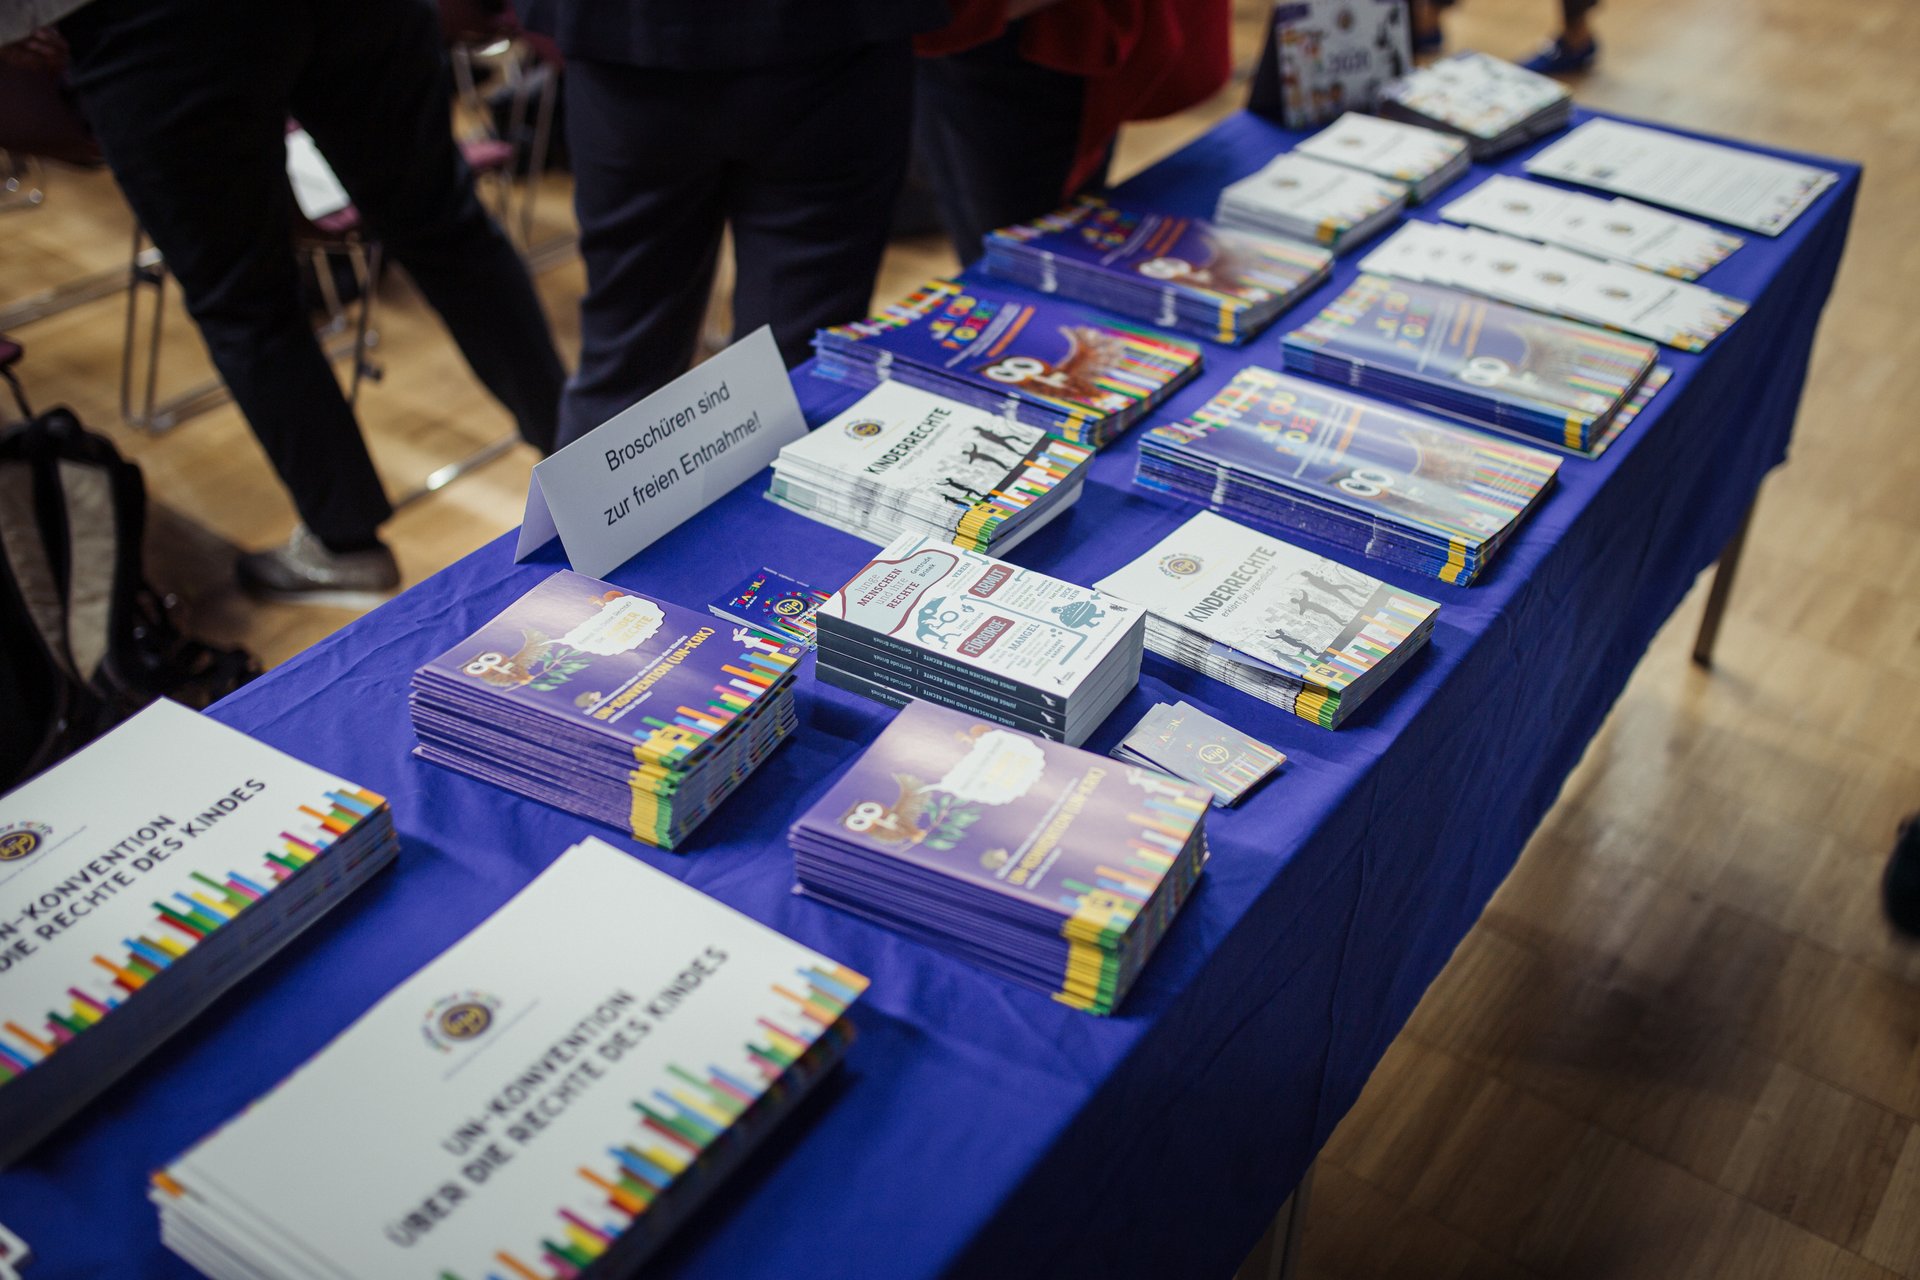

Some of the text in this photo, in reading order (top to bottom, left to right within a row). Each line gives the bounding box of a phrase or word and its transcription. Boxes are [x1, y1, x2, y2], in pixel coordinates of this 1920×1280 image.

[605, 381, 730, 471] Broschüren sind
[864, 407, 951, 475] KINDERRECHTE
[604, 411, 762, 526] zur freien Entnahme!
[911, 556, 932, 574] Gertrude
[857, 568, 902, 606] MENSCHEN
[887, 581, 920, 608] RECHTE
[975, 569, 1007, 594] ARMUT
[1184, 546, 1276, 622] KINDERRECHTE
[778, 600, 801, 614] kija
[666, 627, 715, 664] (UN-KRK)
[963, 619, 1007, 654] FÜRSORGE
[1008, 623, 1040, 651] MANGEL
[923, 654, 943, 665] RECHTE
[956, 666, 968, 675] UND
[923, 672, 943, 683] RECHTE
[956, 684, 969, 693] UND
[969, 670, 998, 685] MENSCHEN
[887, 694, 908, 705] ertrude
[923, 689, 943, 700] RECHTE
[956, 701, 968, 710] UND
[969, 688, 999, 704] MENSCHEN
[968, 706, 998, 720] MENSCHEN
[35, 871, 136, 941] RECHTE
[131, 836, 184, 873] DES
[179, 778, 266, 838] KINDES
[0, 815, 176, 942] N-KONVENTION
[441, 990, 636, 1156] UN-KONVENTION
[461, 1143, 513, 1184] DIE
[505, 1060, 605, 1145] RECHTE
[598, 1018, 652, 1063] DES
[646, 946, 729, 1020] KINDES
